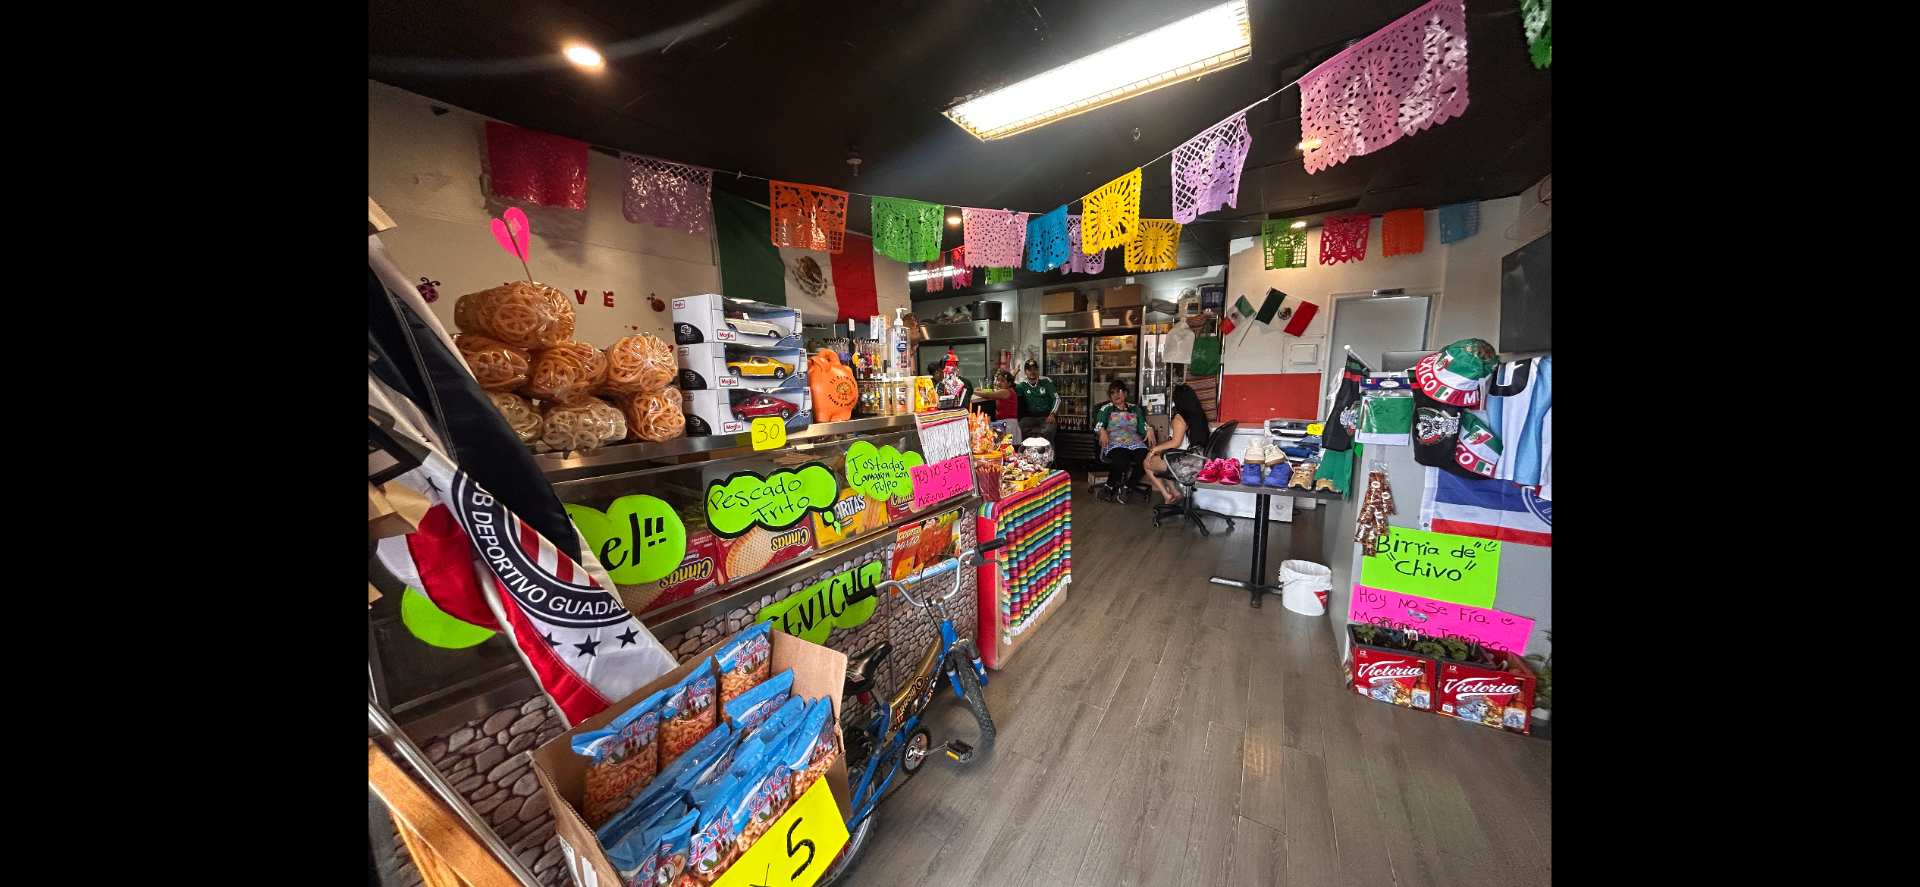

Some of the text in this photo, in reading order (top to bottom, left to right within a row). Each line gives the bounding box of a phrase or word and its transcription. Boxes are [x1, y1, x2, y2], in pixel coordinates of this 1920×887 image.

[755, 424, 780, 443] 30
[1308, 424, 1320, 432] 30
[848, 454, 905, 472] Tostadas
[708, 477, 802, 510] Pescado
[751, 495, 810, 523] Frito
[599, 512, 666, 571] el!!
[772, 527, 811, 551] Cinnas
[1376, 534, 1440, 555] Birria
[472, 511, 623, 615] DEPORTIVO GUADA
[660, 558, 713, 588] Cinnas
[769, 566, 873, 636] EVICHE
[1359, 588, 1386, 609] Hoy
[1357, 660, 1424, 680] Victoria
[1443, 677, 1521, 696] Victoria
[786, 817, 816, 882] 5
